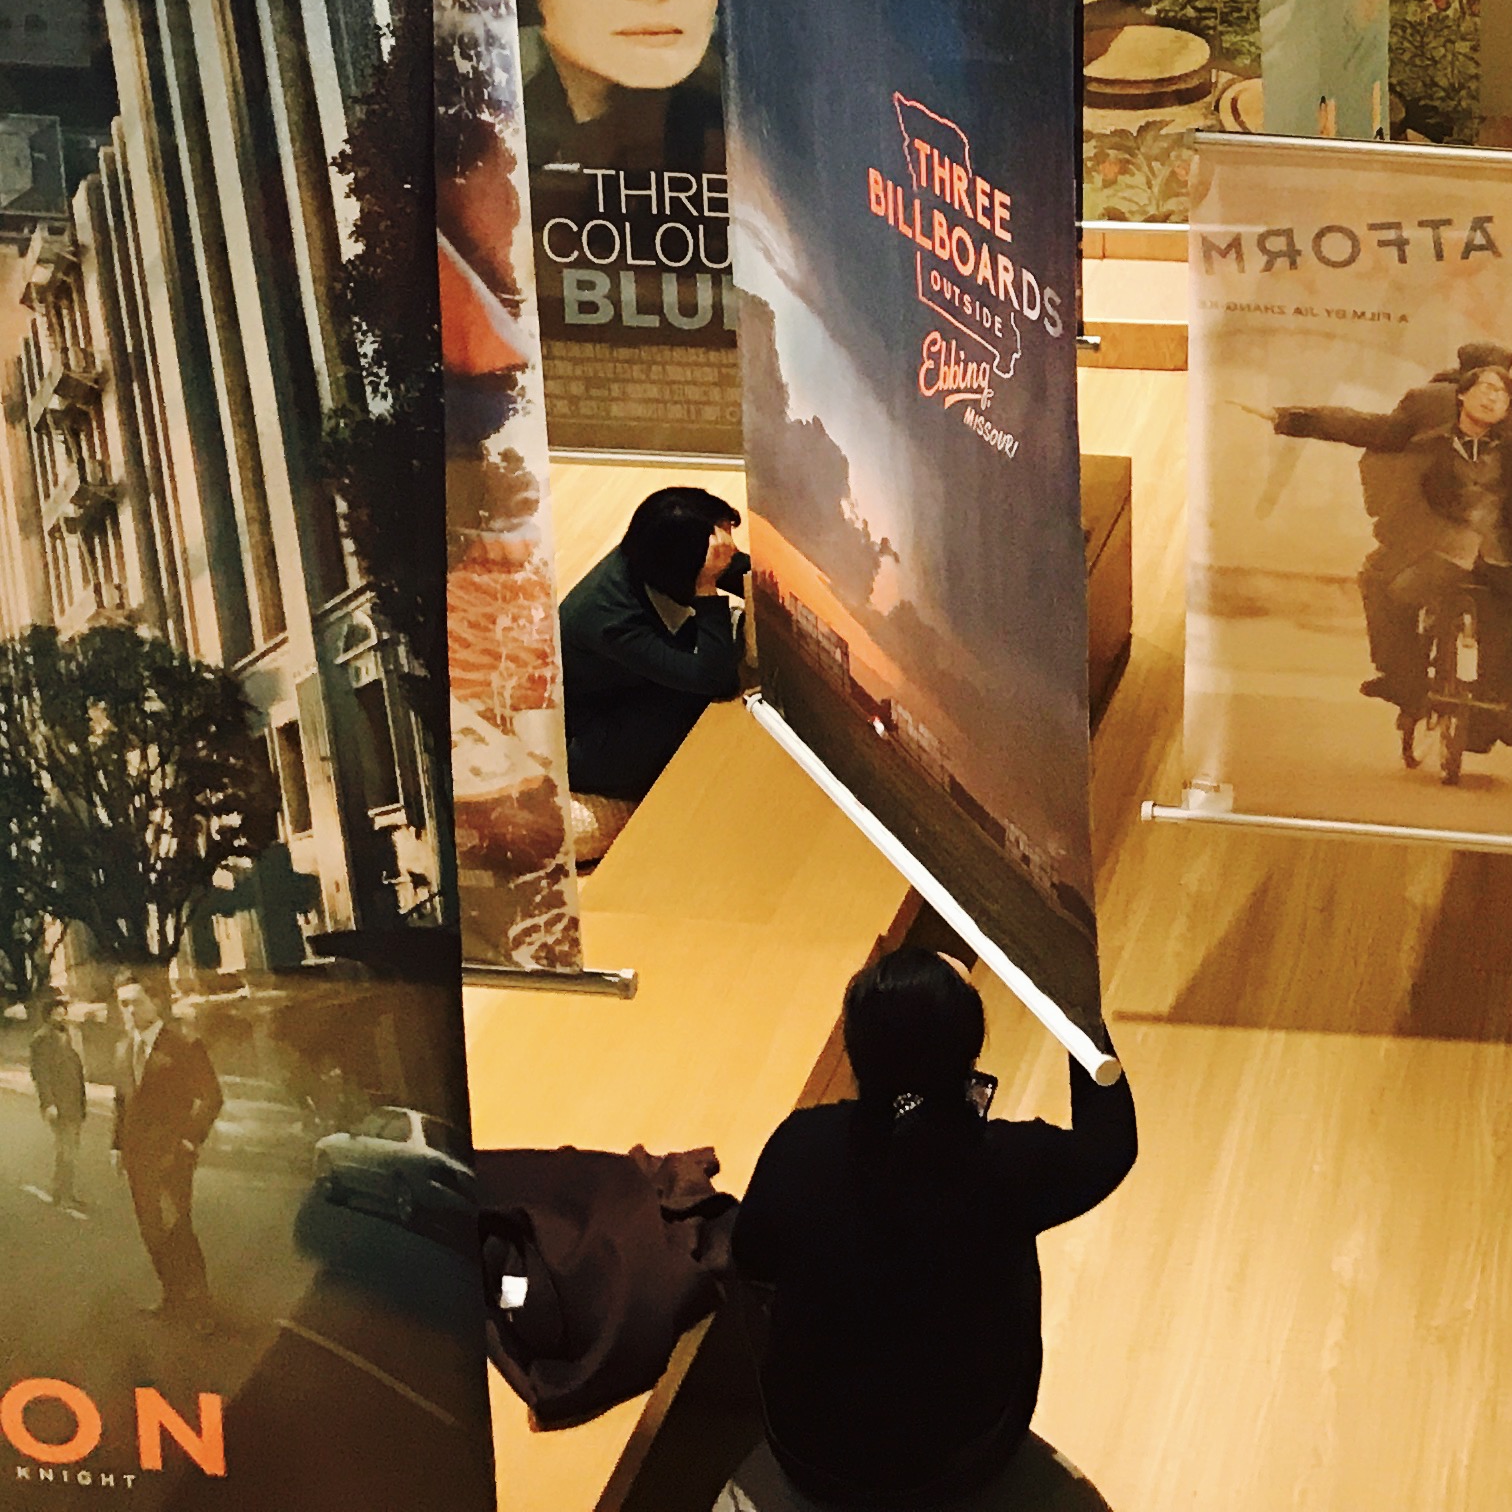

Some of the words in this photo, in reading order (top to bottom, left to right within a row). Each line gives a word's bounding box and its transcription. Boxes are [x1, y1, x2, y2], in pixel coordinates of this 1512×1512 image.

[583, 167, 731, 218] THRE
[913, 138, 1013, 243] THREE
[542, 217, 734, 269] COLOU
[867, 167, 1065, 338] BILLBOARDS
[929, 268, 1004, 339] OUTSIDE
[962, 405, 1019, 459] MISSOURI
[0, 1377, 227, 1478] ON
[16, 1466, 137, 1489] KNIGHT
